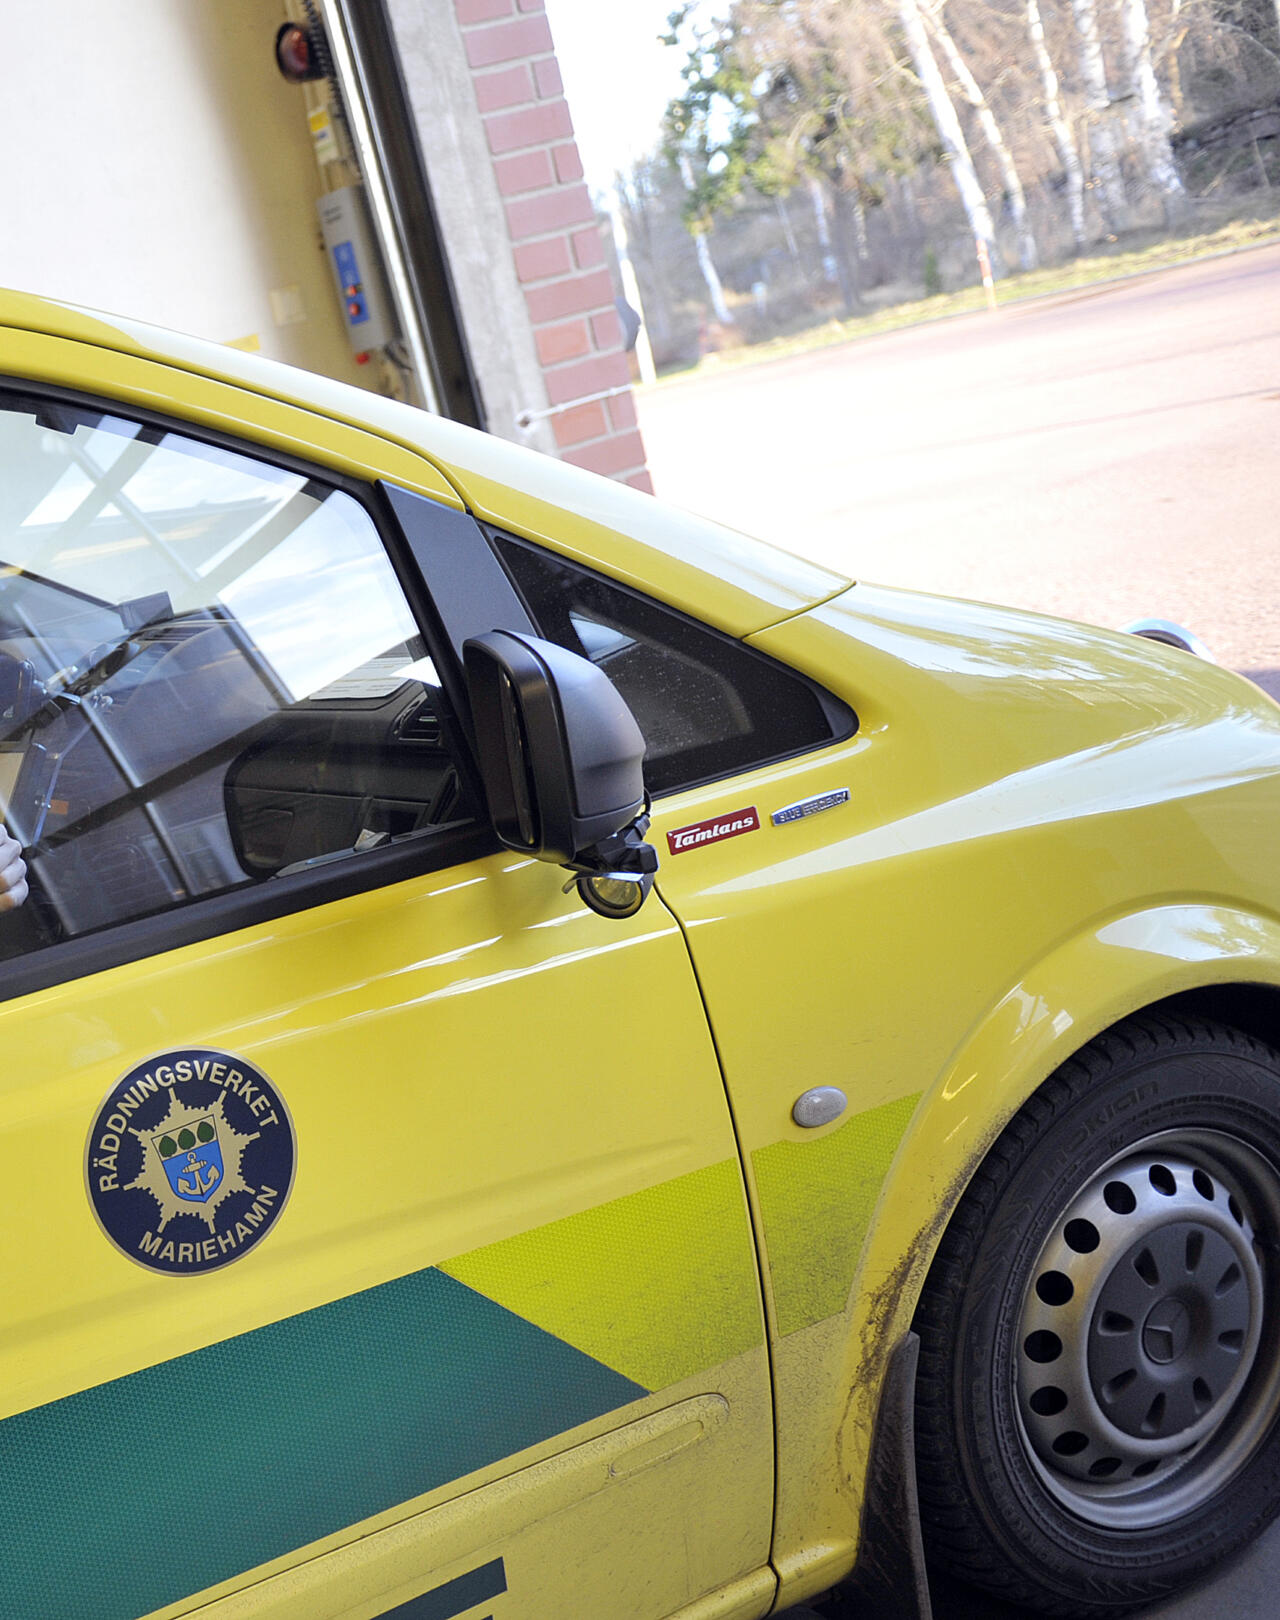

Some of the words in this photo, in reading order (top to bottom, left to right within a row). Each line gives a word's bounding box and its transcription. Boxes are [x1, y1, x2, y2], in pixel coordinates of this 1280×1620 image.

[669, 817, 754, 849] Tamlans
[93, 1060, 279, 1192] RÄDDNINGSVERKET
[138, 1185, 278, 1263] MARIEHAMN
